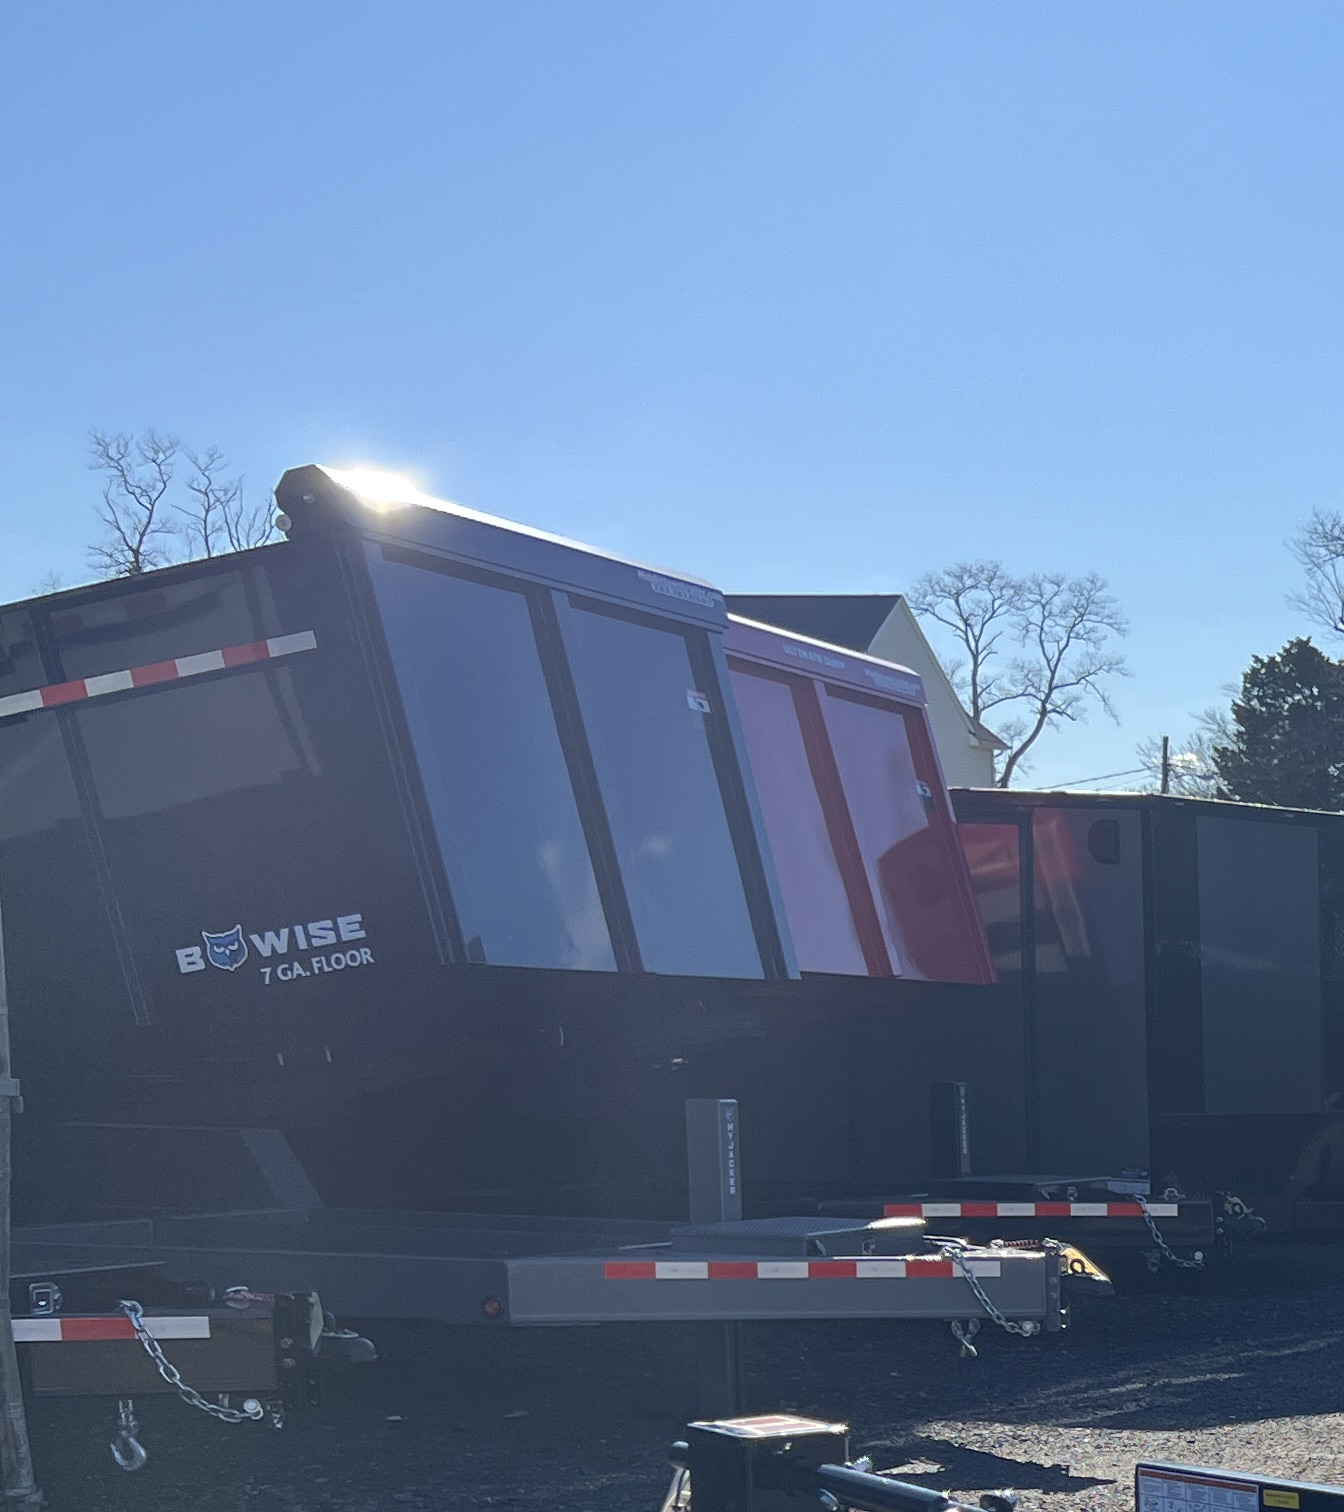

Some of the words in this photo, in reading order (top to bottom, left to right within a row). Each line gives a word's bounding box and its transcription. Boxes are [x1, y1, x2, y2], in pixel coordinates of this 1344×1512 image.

[260, 967, 272, 985] 7
[276, 961, 311, 981] GA.
[311, 947, 375, 974] FLOOR
